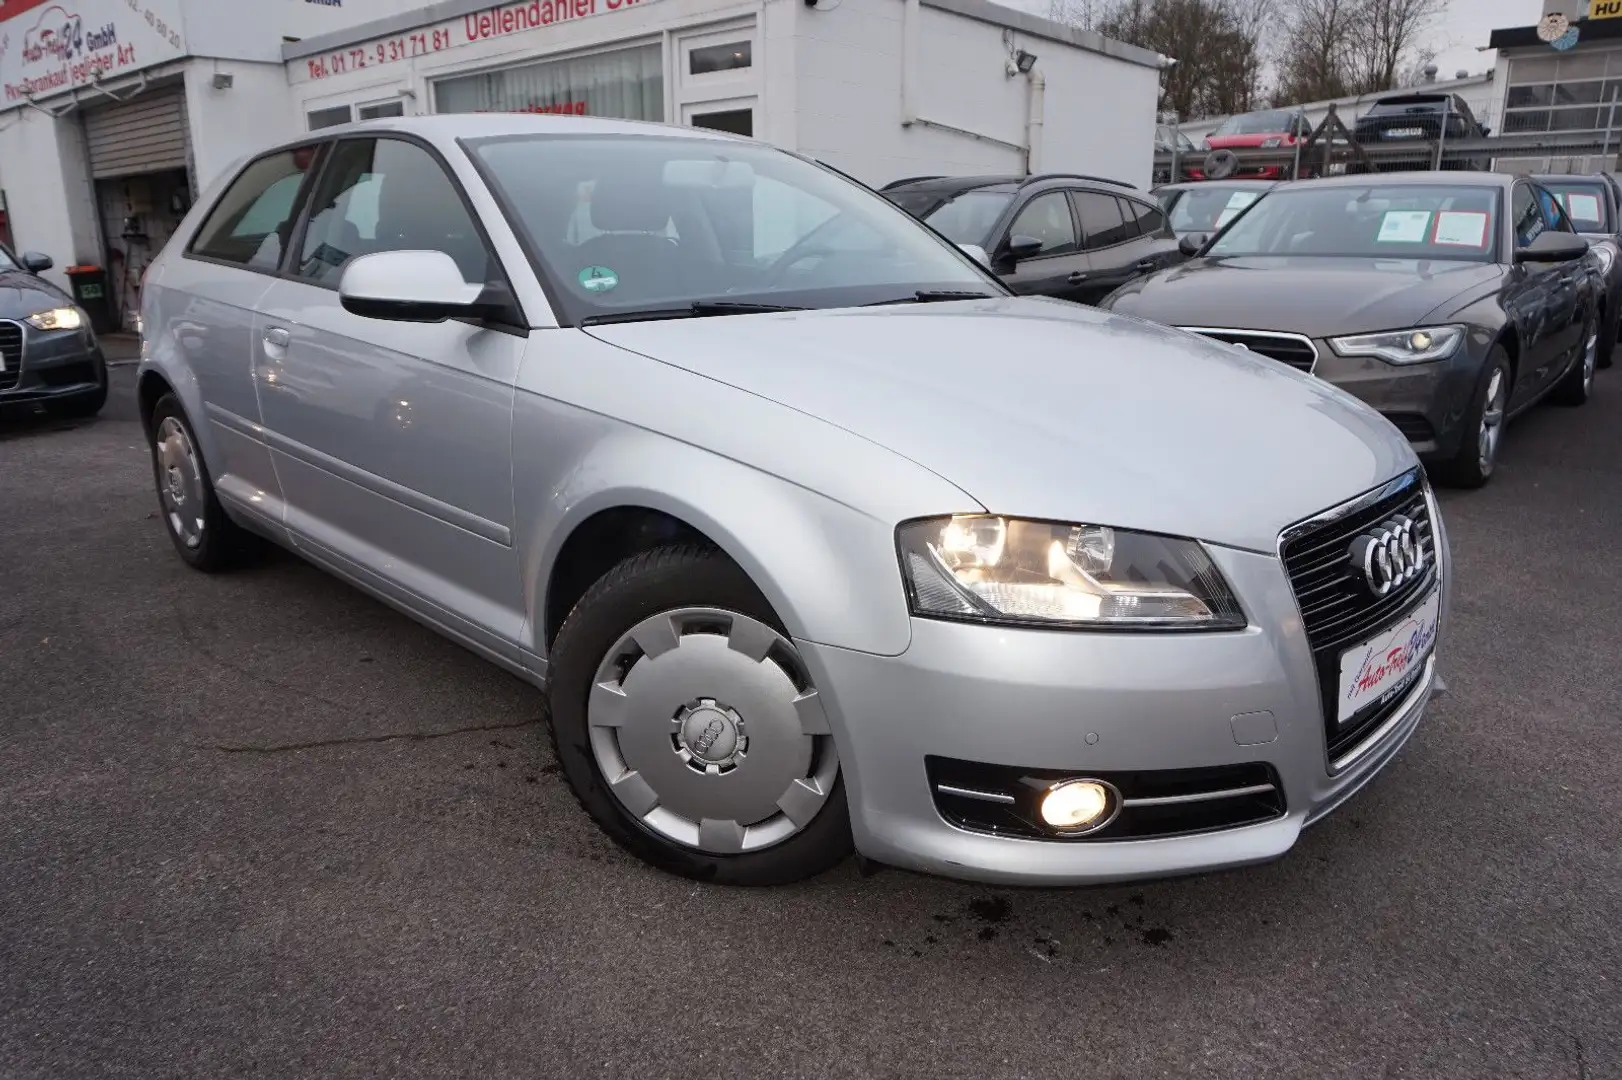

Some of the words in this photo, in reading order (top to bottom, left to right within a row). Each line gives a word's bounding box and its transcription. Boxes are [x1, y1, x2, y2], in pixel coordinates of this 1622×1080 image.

[464, 0, 596, 41] Uellendahler
[1595, 2, 1621, 16] HU
[86, 22, 117, 52] GmbH
[168, 29, 180, 49] 20
[117, 42, 136, 69] Art
[307, 56, 329, 79] Tel.
[331, 53, 346, 74] 01
[349, 48, 365, 69] 72
[376, 43, 385, 64] 9
[388, 39, 405, 61] 31
[410, 33, 427, 55] 71
[432, 28, 450, 51] 81
